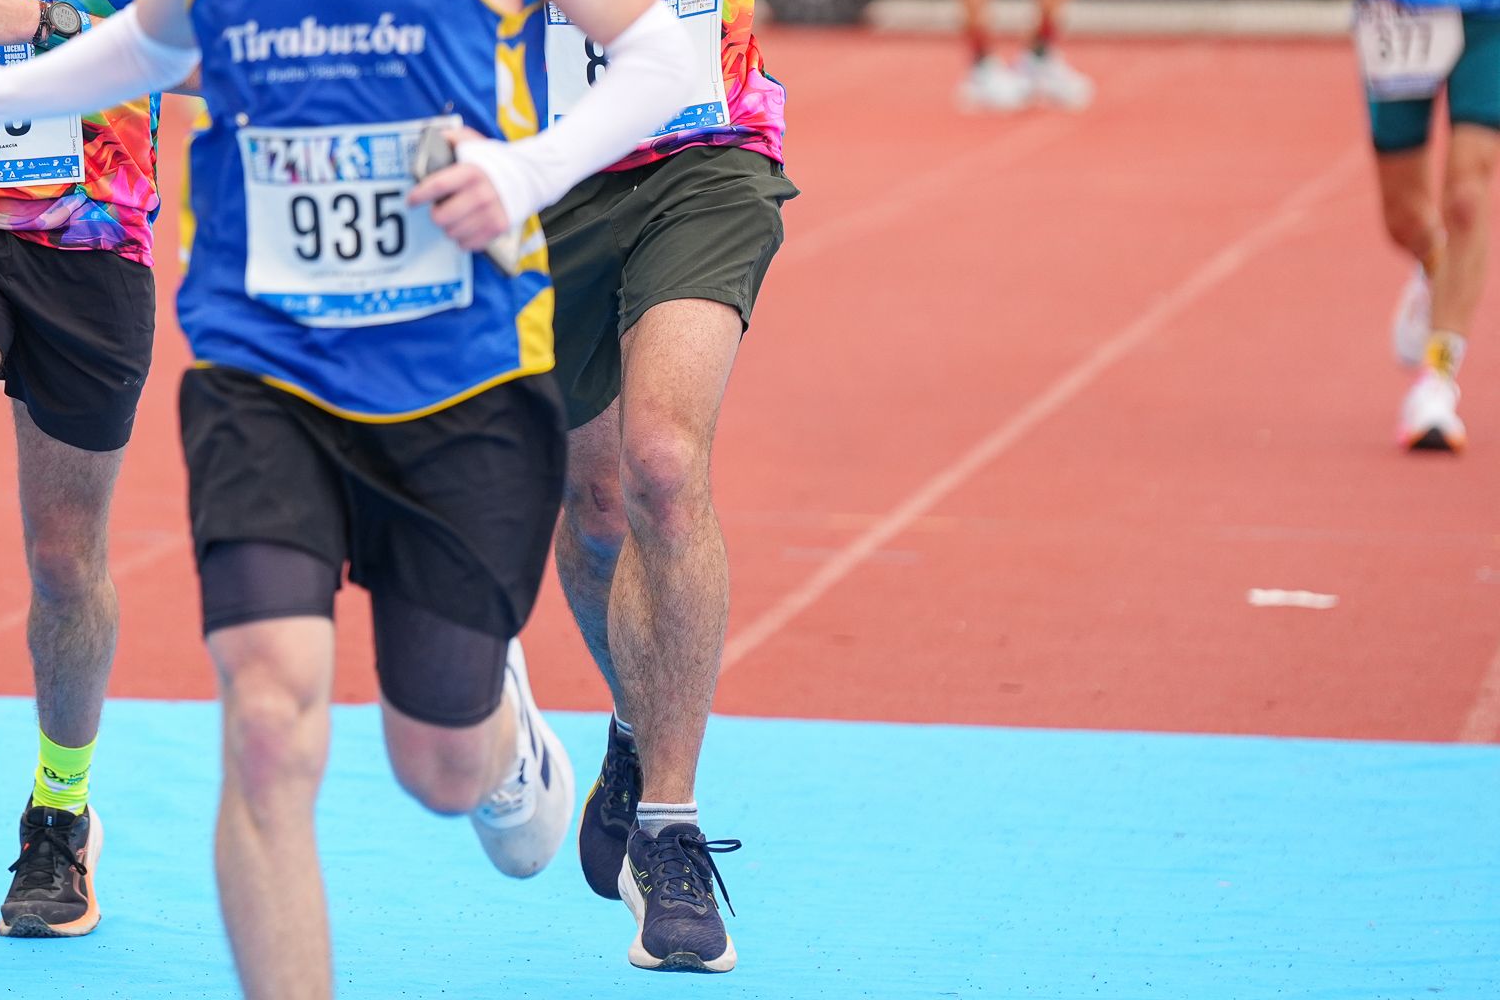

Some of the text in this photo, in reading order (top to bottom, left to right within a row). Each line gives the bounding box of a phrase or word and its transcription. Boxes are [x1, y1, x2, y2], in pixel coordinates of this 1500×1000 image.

[3, 44, 25, 53] LUCENA
[222, 12, 426, 63] Tirabuzón
[291, 191, 405, 261] 935
